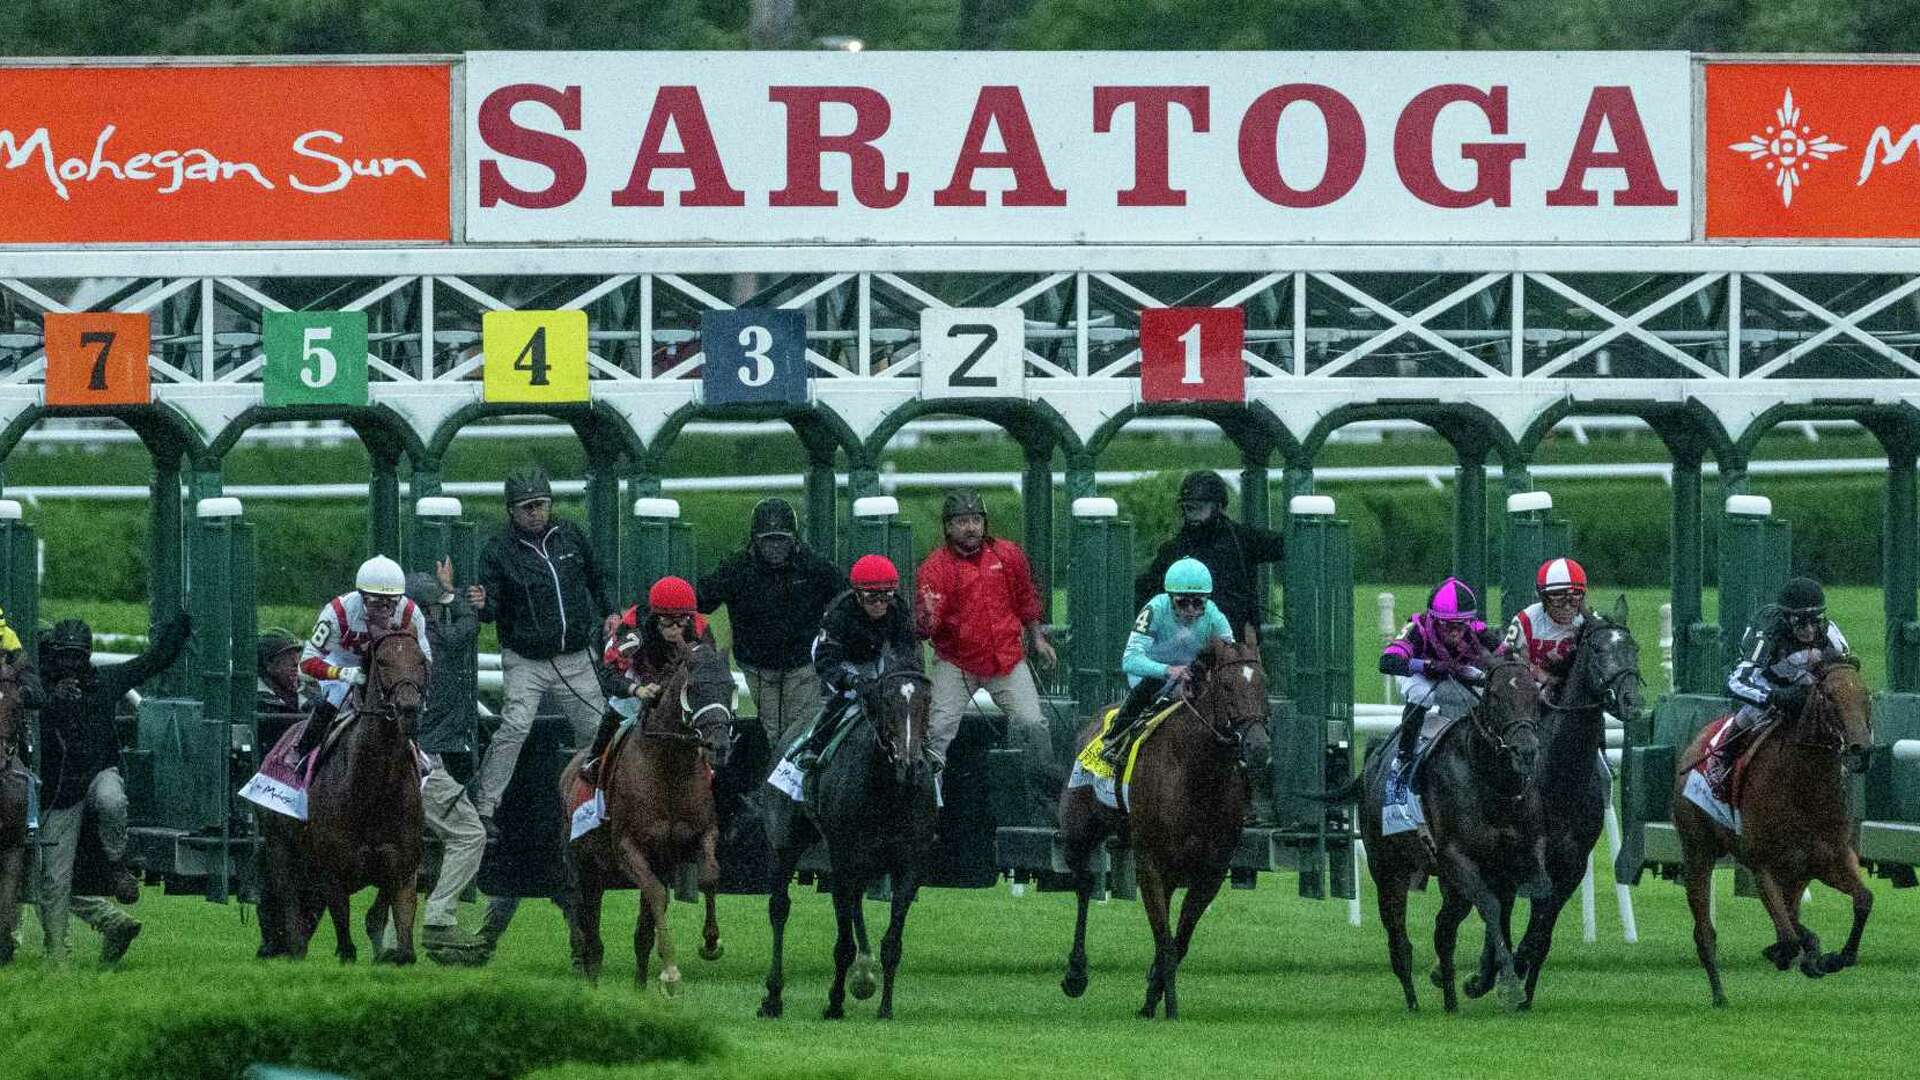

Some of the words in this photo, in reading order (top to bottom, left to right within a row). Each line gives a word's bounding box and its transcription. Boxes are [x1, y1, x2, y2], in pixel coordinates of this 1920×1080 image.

[0, 124, 275, 201] Mohegan
[288, 130, 427, 194] Sun
[479, 85, 1678, 208] SARATOGA
[79, 331, 117, 391] 7
[300, 326, 337, 388] 5
[513, 326, 552, 386] 4
[737, 325, 775, 387] 3
[947, 323, 998, 387] 2
[1177, 323, 1204, 384] 1
[311, 621, 331, 649] 8
[1135, 609, 1150, 633] 4
